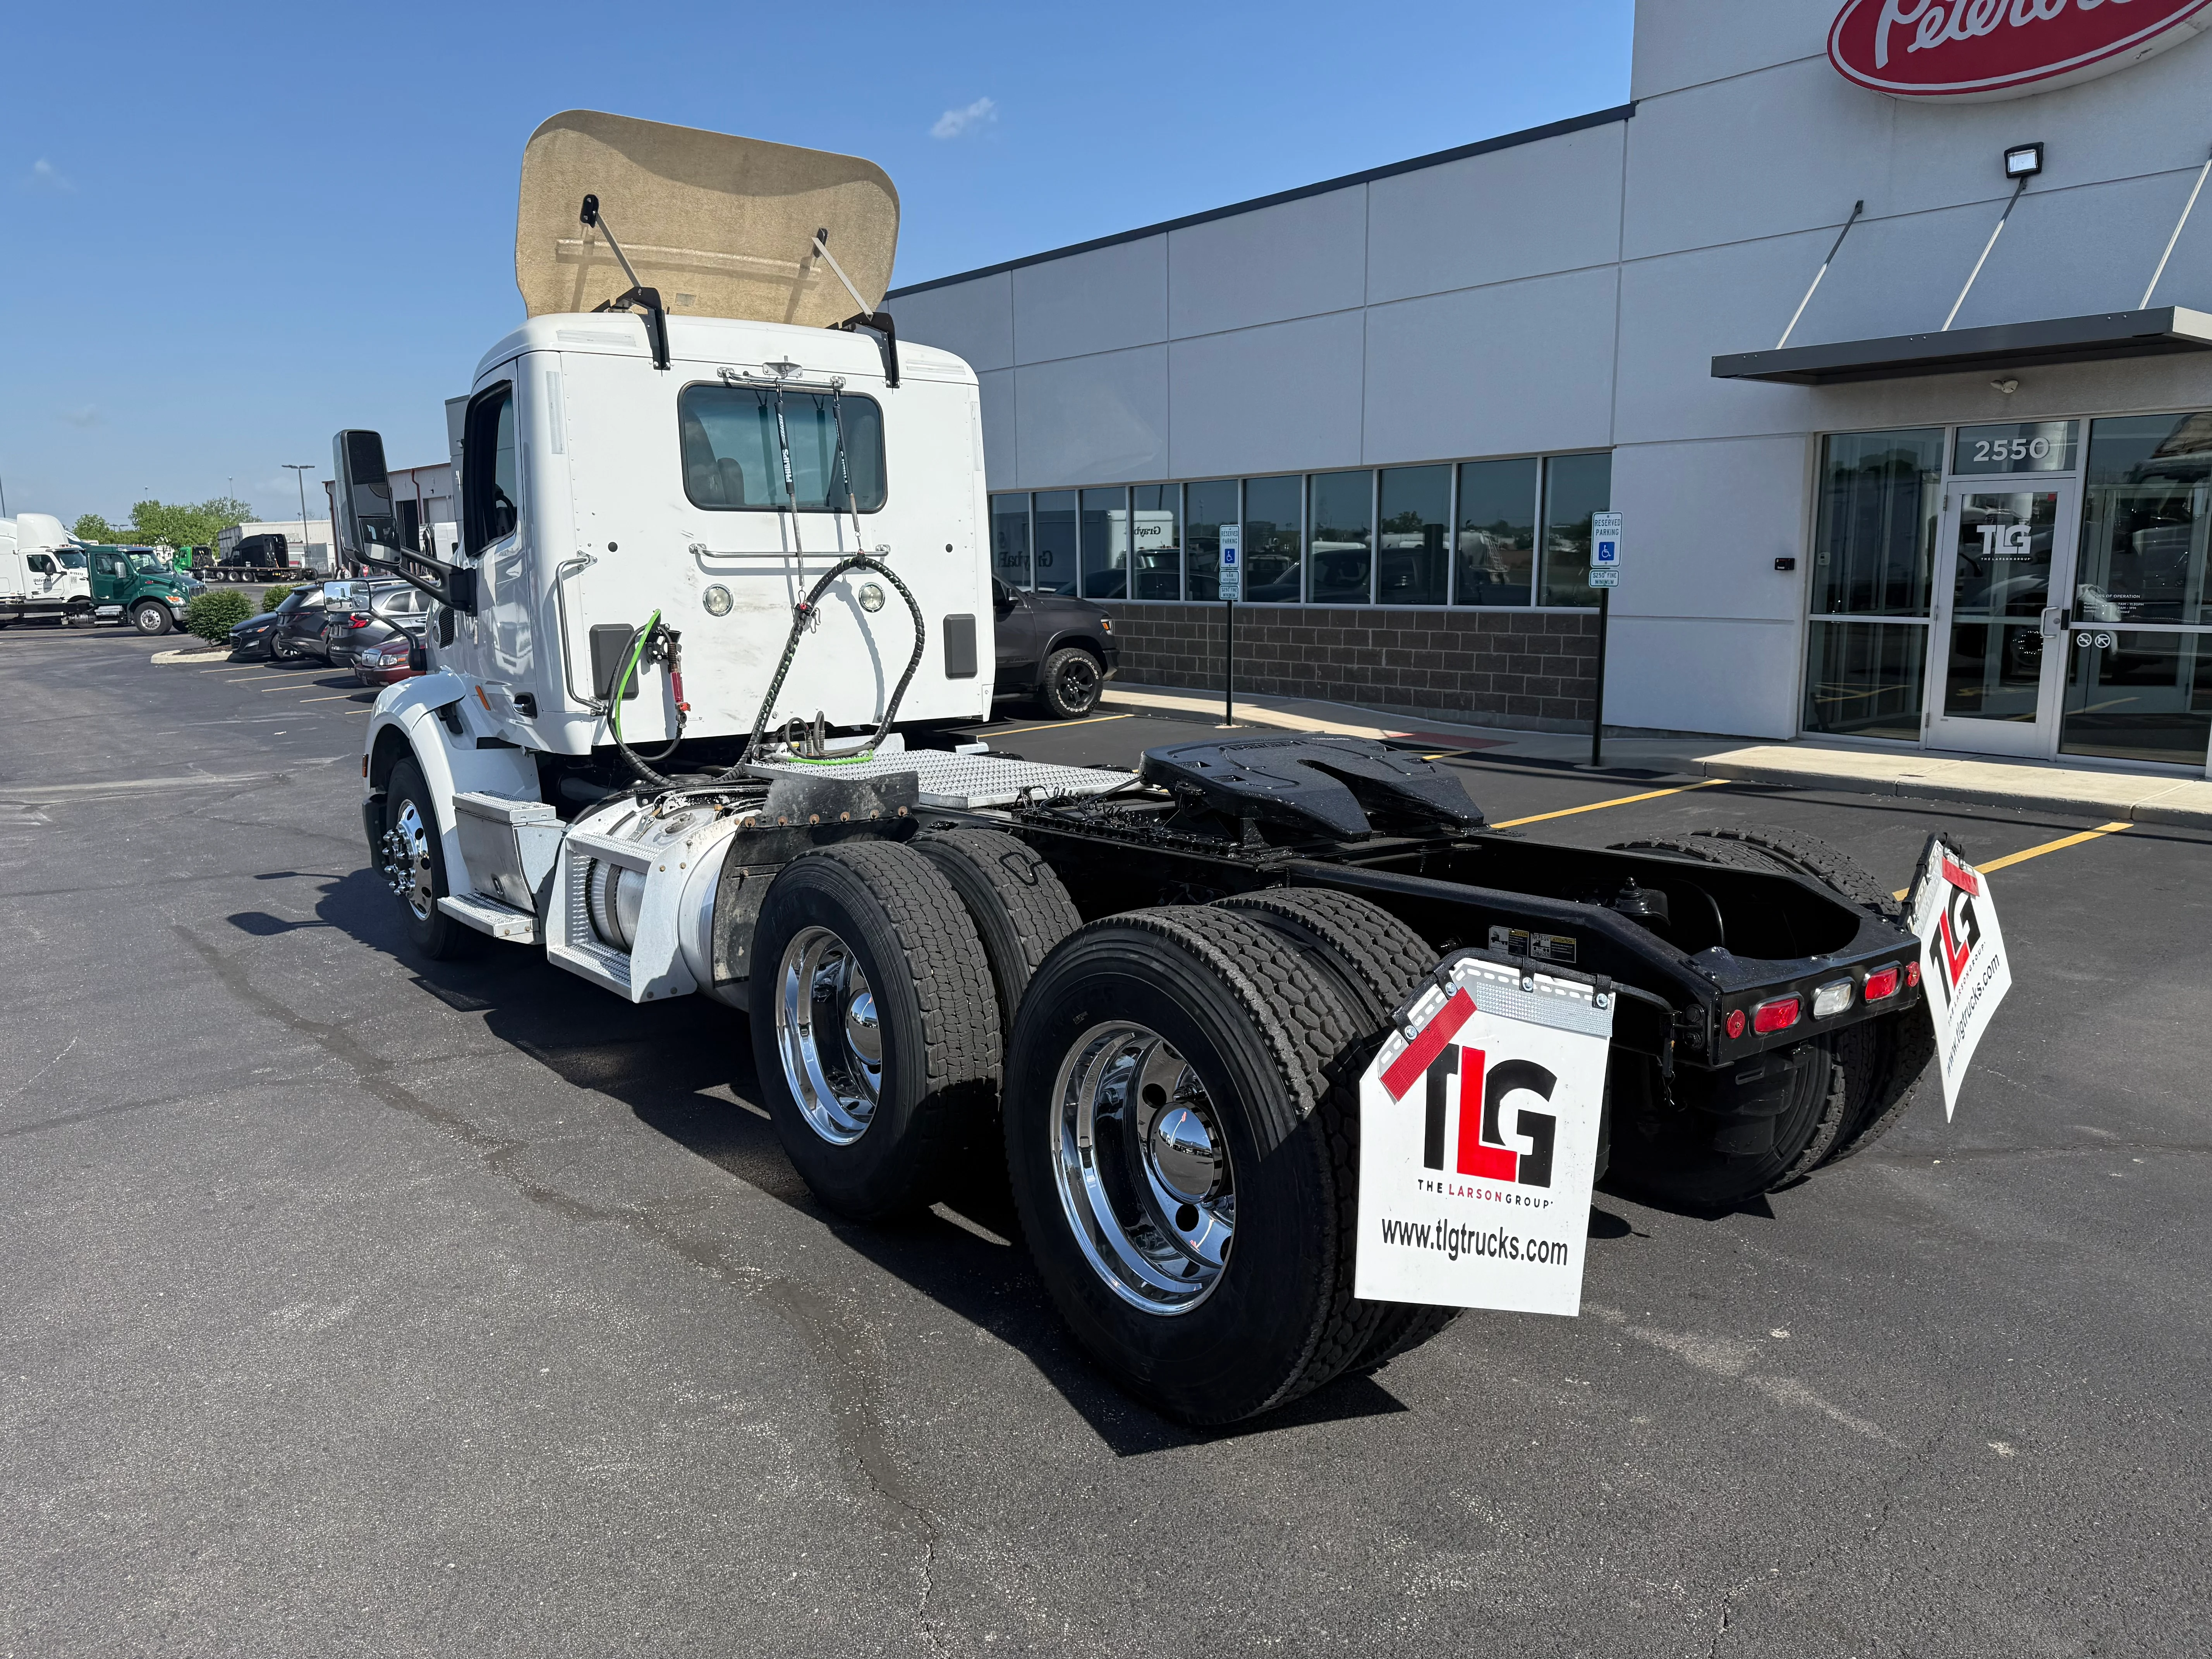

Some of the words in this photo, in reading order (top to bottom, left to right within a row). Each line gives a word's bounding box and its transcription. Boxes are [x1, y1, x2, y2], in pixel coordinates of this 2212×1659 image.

[1973, 437, 2050, 462] 2550
[1976, 524, 2032, 554] TLG
[1947, 954, 2000, 1078] www.tlgtrucks.com
[1424, 1043, 1557, 1188] TLG
[1418, 1179, 1443, 1194] THE
[1381, 1217, 1568, 1266] www.tlgtrucks.com
